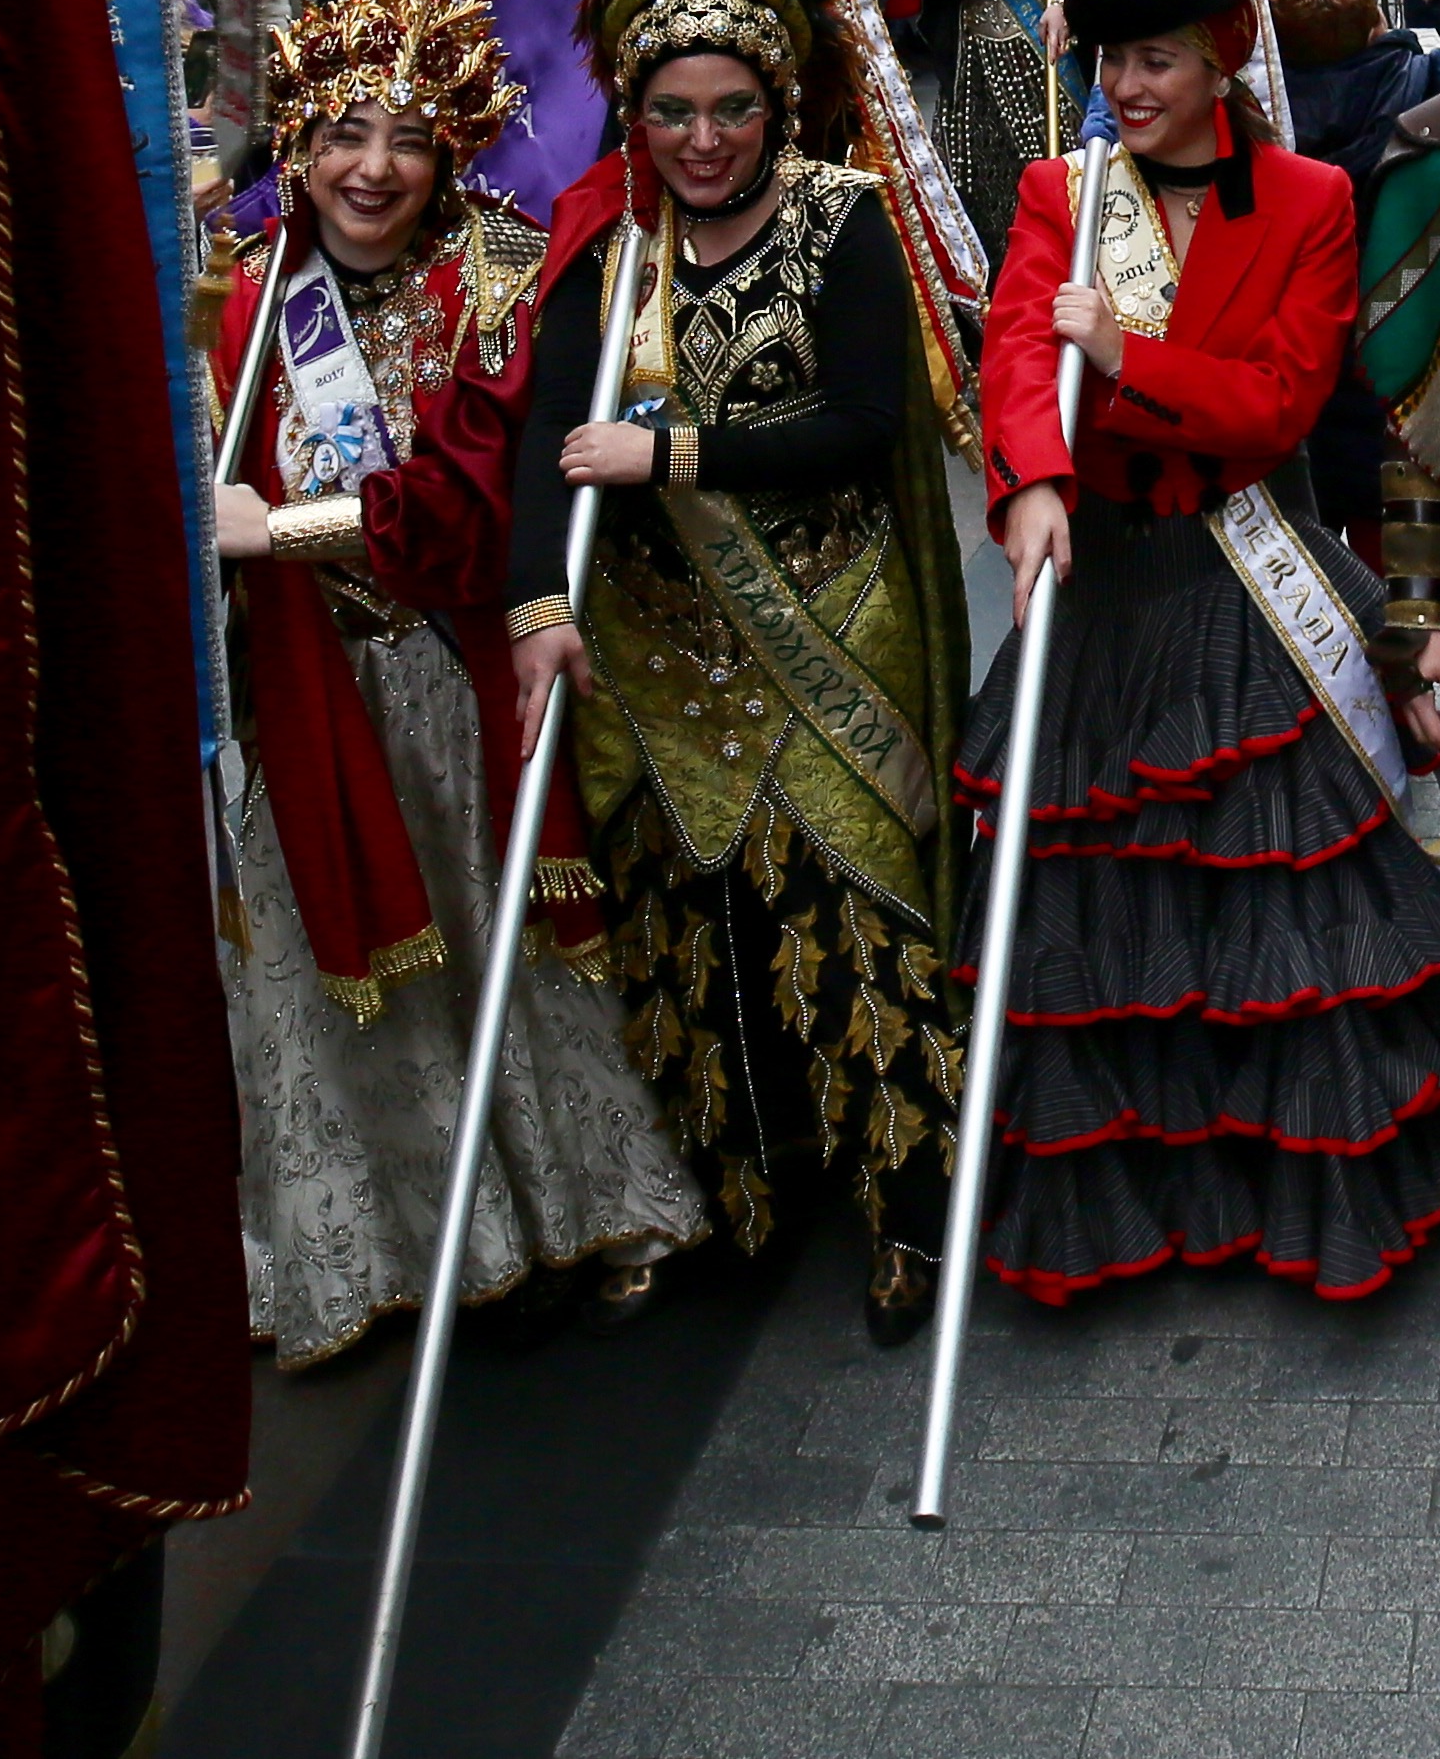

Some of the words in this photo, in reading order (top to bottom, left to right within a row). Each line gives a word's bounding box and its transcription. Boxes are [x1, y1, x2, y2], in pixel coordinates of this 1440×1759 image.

[1115, 260, 1156, 286] 2014
[315, 366, 345, 388] 2017
[704, 529, 905, 770] ABANDERADA
